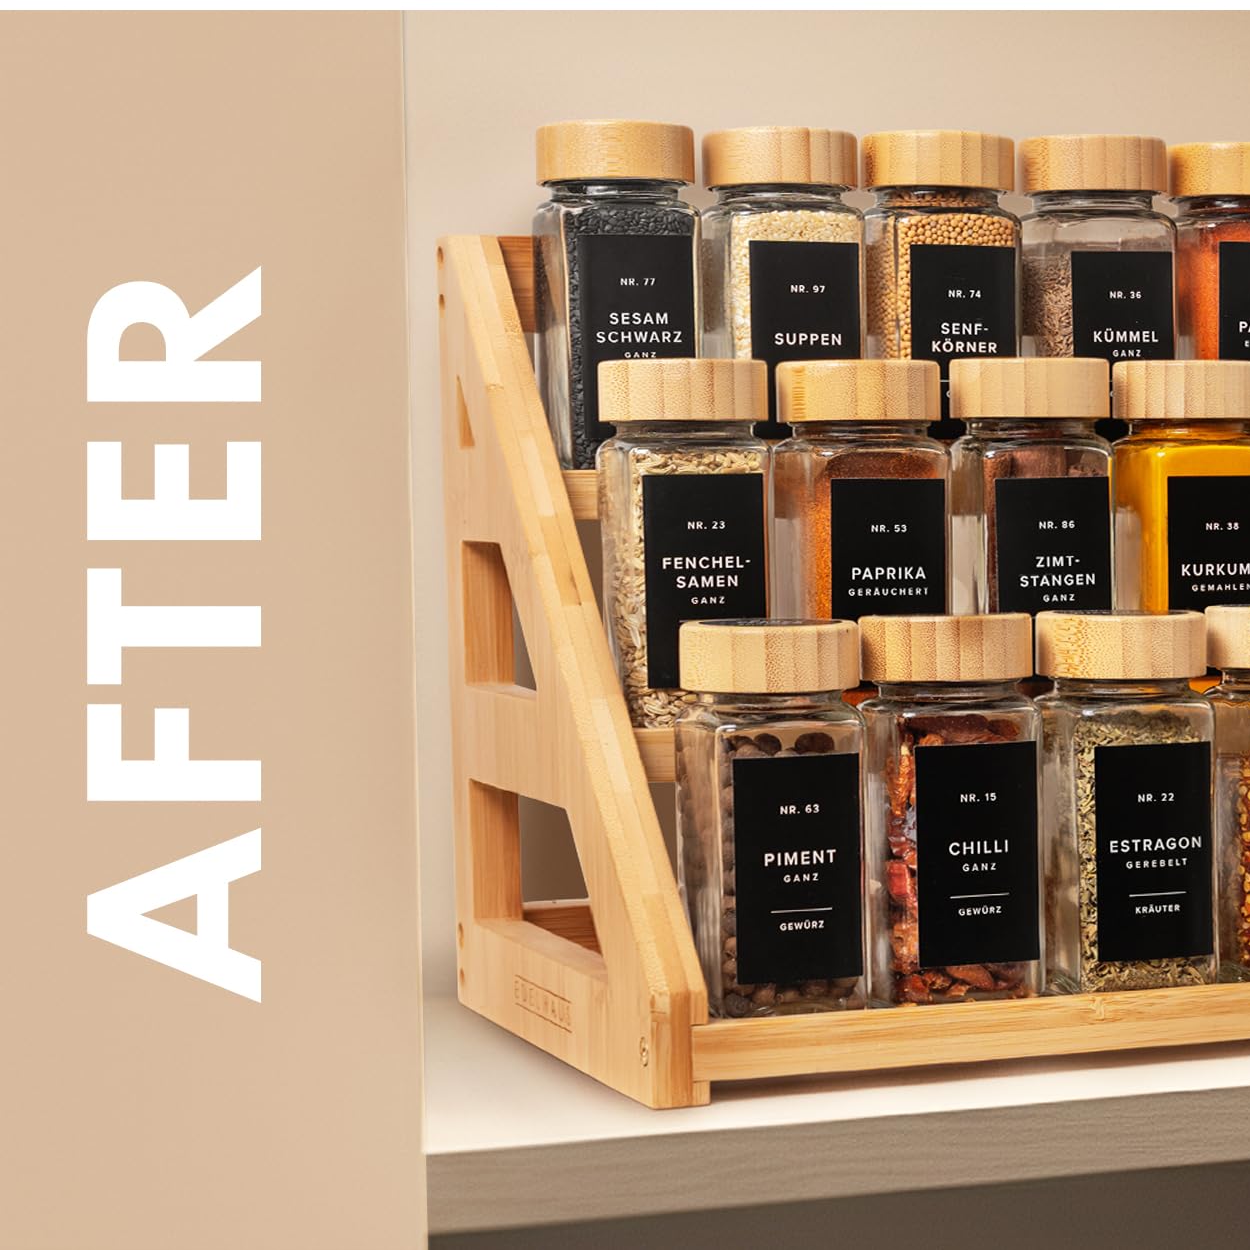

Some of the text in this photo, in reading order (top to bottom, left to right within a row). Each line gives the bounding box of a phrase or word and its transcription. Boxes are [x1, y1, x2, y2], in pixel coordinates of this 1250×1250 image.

[620, 277, 656, 286] NR. 77
[790, 284, 826, 294] NR. 97
[948, 289, 982, 299] NR. 74
[1109, 290, 1142, 299] NR. 36
[609, 312, 669, 325] SESAM
[941, 323, 988, 335] SENF-
[1094, 328, 1158, 342] KÜMMEL
[597, 331, 682, 343] SCHWARZ
[775, 333, 841, 345] SUPPEN
[932, 338, 997, 353] KÖRNER
[623, 350, 658, 359] GANZ
[1112, 349, 1141, 358] GANZ
[687, 520, 726, 530] NR. 23
[870, 524, 908, 533] NR. 53
[1038, 519, 1076, 530] NR. 86
[1205, 521, 1240, 531] NR. 38
[663, 556, 750, 569] FENCHEL-
[1035, 555, 1080, 568] ZIMT-
[852, 567, 926, 580] PAPRIKA
[677, 575, 738, 588] SAMEN
[1020, 574, 1095, 587] STANGEN
[690, 595, 725, 605] GANZ
[1042, 593, 1075, 603] GANZ
[960, 792, 997, 803] NR. 15
[1137, 792, 1175, 803] NR. 22
[779, 803, 820, 815] NR. 63
[949, 840, 1008, 855] CHILLI
[1110, 836, 1201, 853] ESTRAGON
[765, 849, 836, 866] PIMENT
[1125, 857, 1188, 870] GEREBELT
[962, 862, 997, 873] GANZ
[783, 872, 819, 884] GANZ
[958, 905, 1002, 917] GEWÜRZ
[1135, 903, 1181, 915] KRÄUTER
[779, 919, 825, 932] GEWÜRZ
